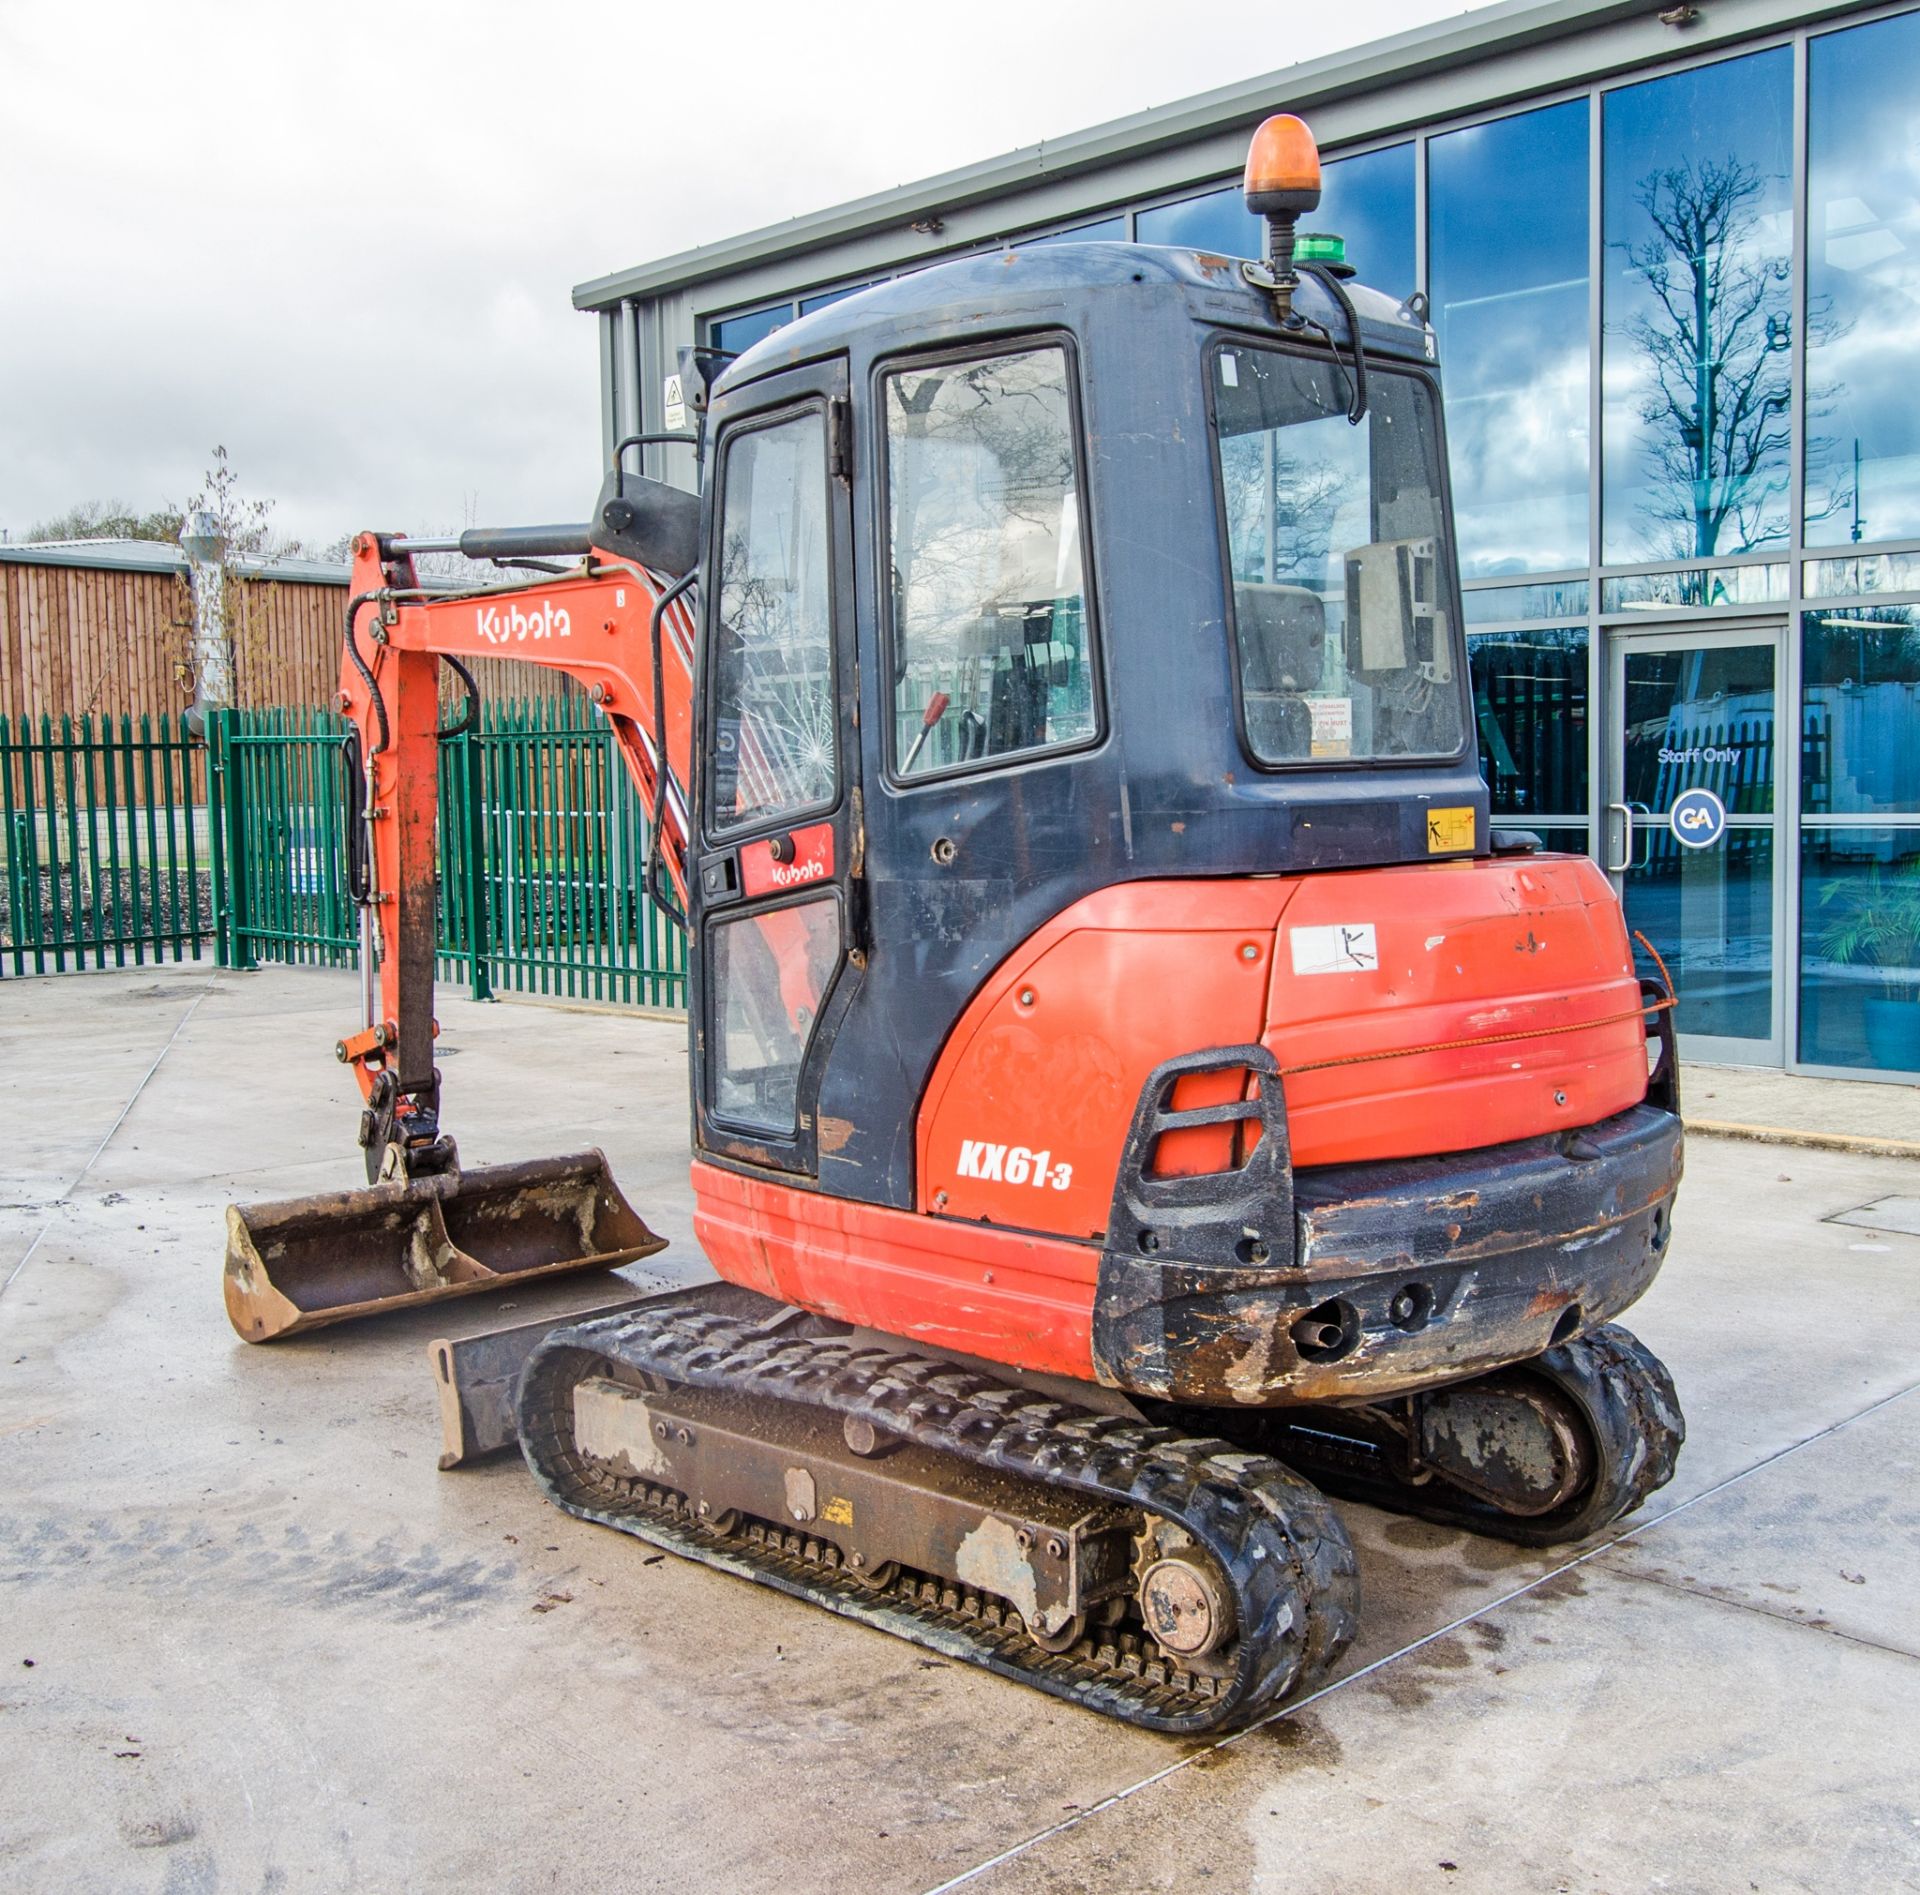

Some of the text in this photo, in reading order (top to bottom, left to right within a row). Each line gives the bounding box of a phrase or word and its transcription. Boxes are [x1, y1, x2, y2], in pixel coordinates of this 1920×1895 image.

[477, 600, 571, 644] Kubota
[1658, 747, 1741, 766] Staff Only
[1679, 807, 1715, 830] GA
[771, 859, 824, 886] Kubota
[956, 1139, 1073, 1191] KX61-3
